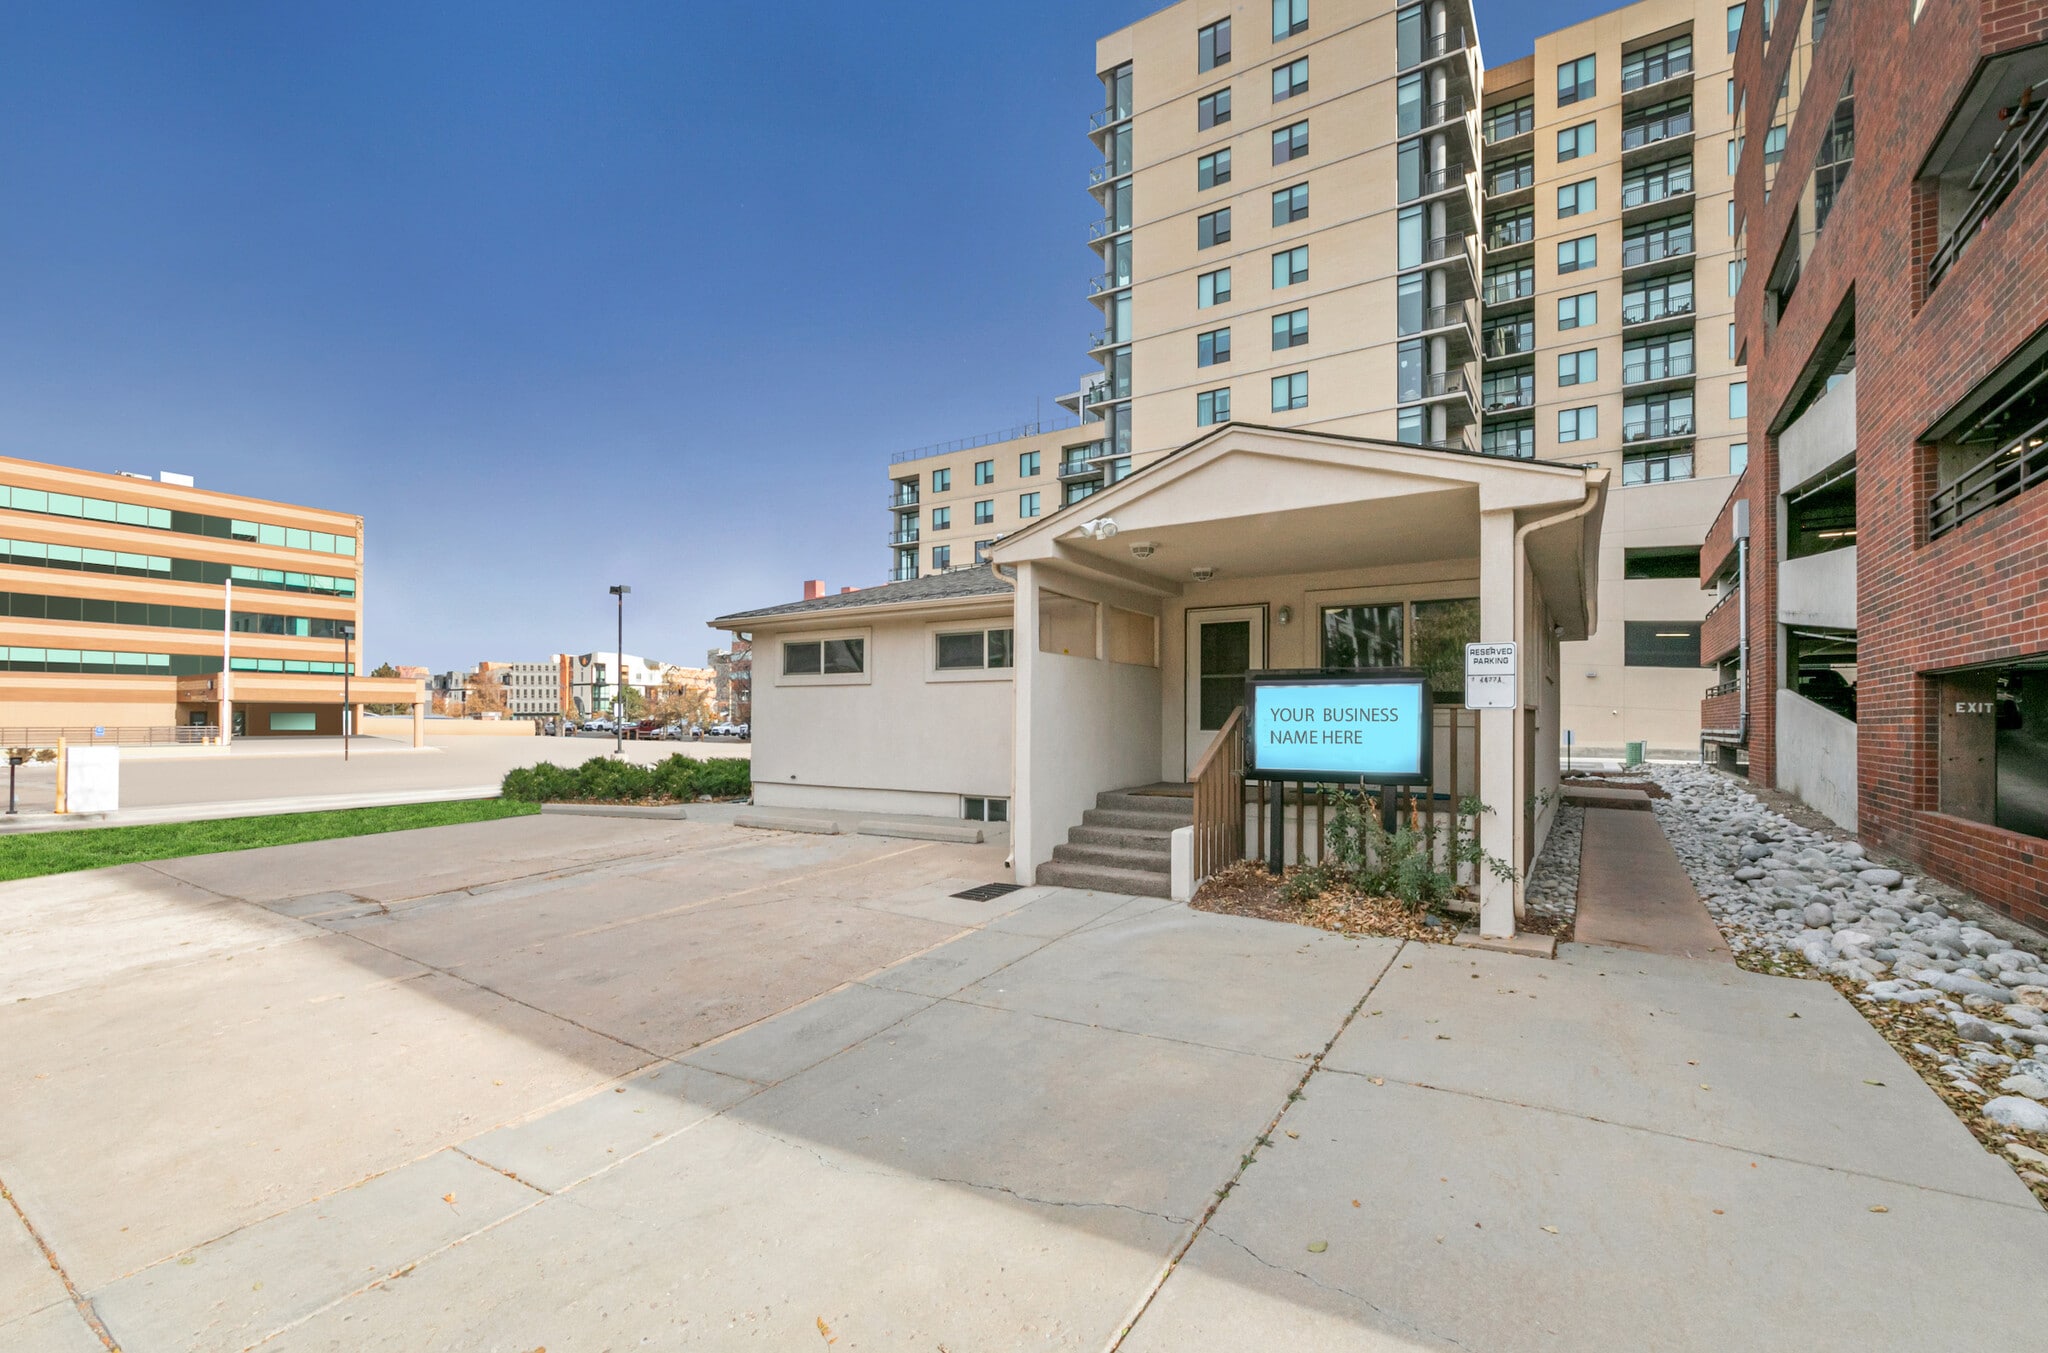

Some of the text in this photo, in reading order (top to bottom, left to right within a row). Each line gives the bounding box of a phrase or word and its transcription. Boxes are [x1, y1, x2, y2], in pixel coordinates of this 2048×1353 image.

[1470, 648, 1513, 656] RESERVED
[1955, 702, 1994, 713] EXIT
[1270, 708, 1399, 722] YOUR BUSINESS
[1270, 730, 1363, 744] NAME HERE
